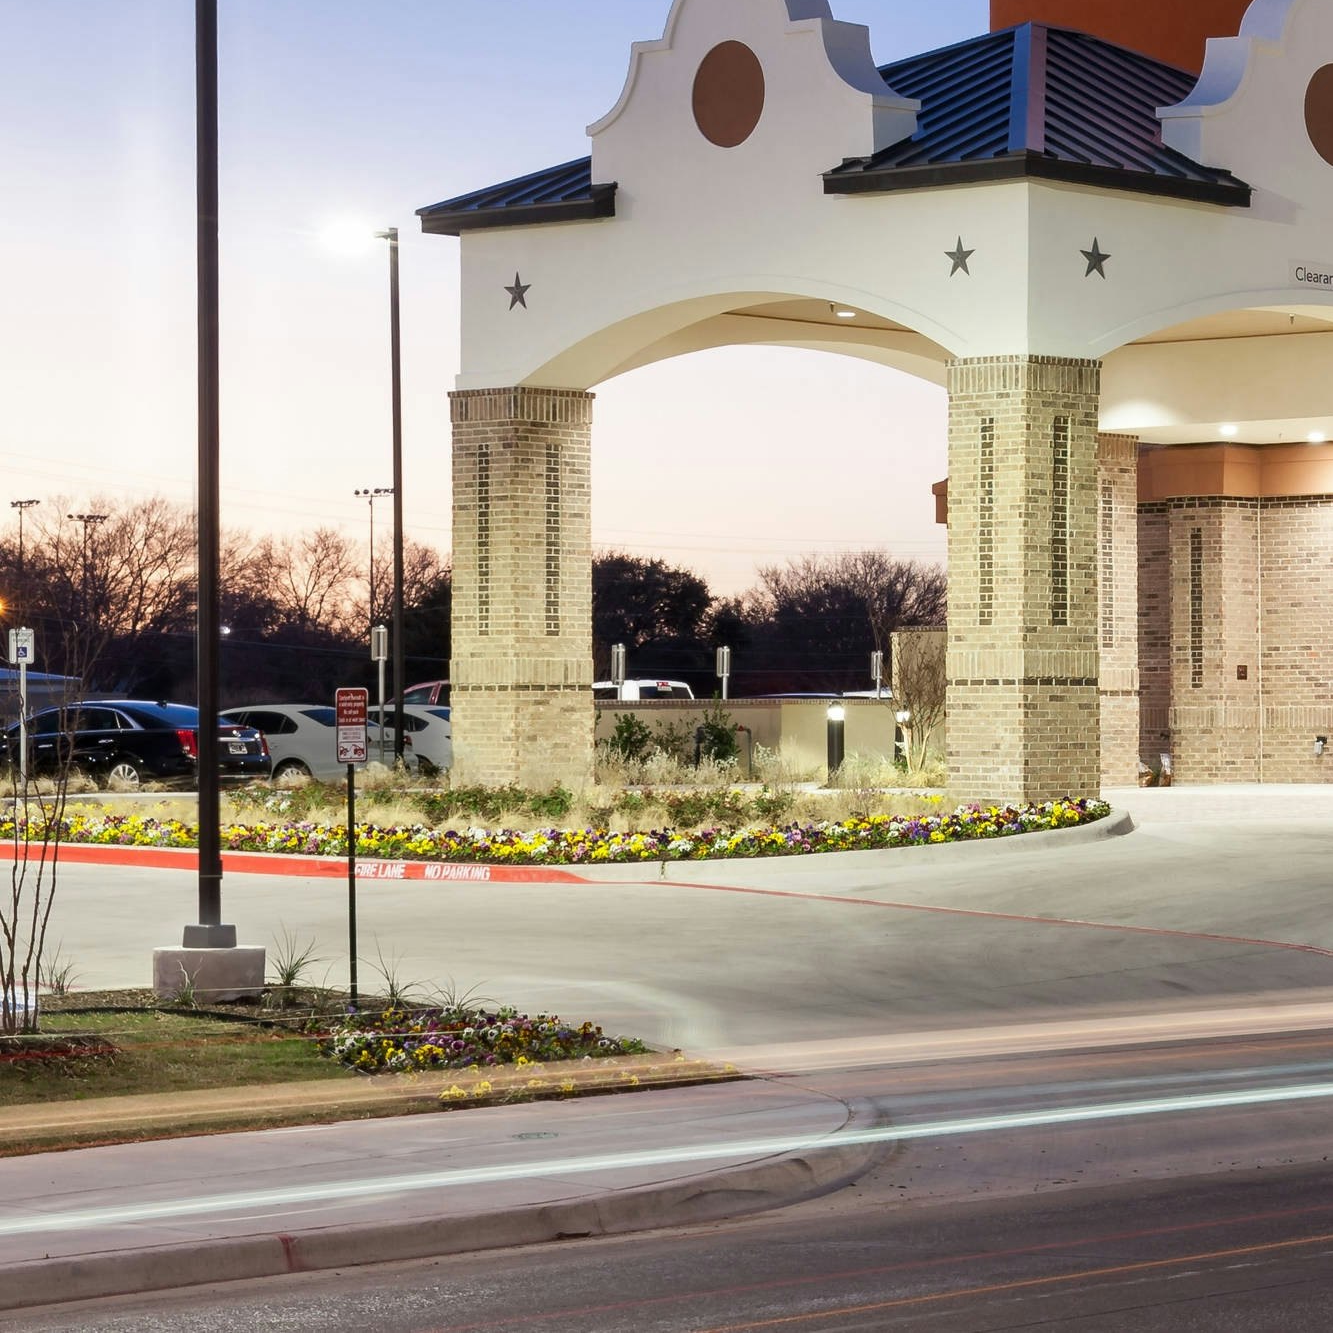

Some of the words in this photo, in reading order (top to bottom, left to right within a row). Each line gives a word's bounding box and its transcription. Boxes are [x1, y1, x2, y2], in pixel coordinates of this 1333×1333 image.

[355, 863, 378, 877] FIRE
[378, 863, 406, 879] LANE
[424, 864, 441, 879] NO
[441, 865, 491, 881] PARKING
